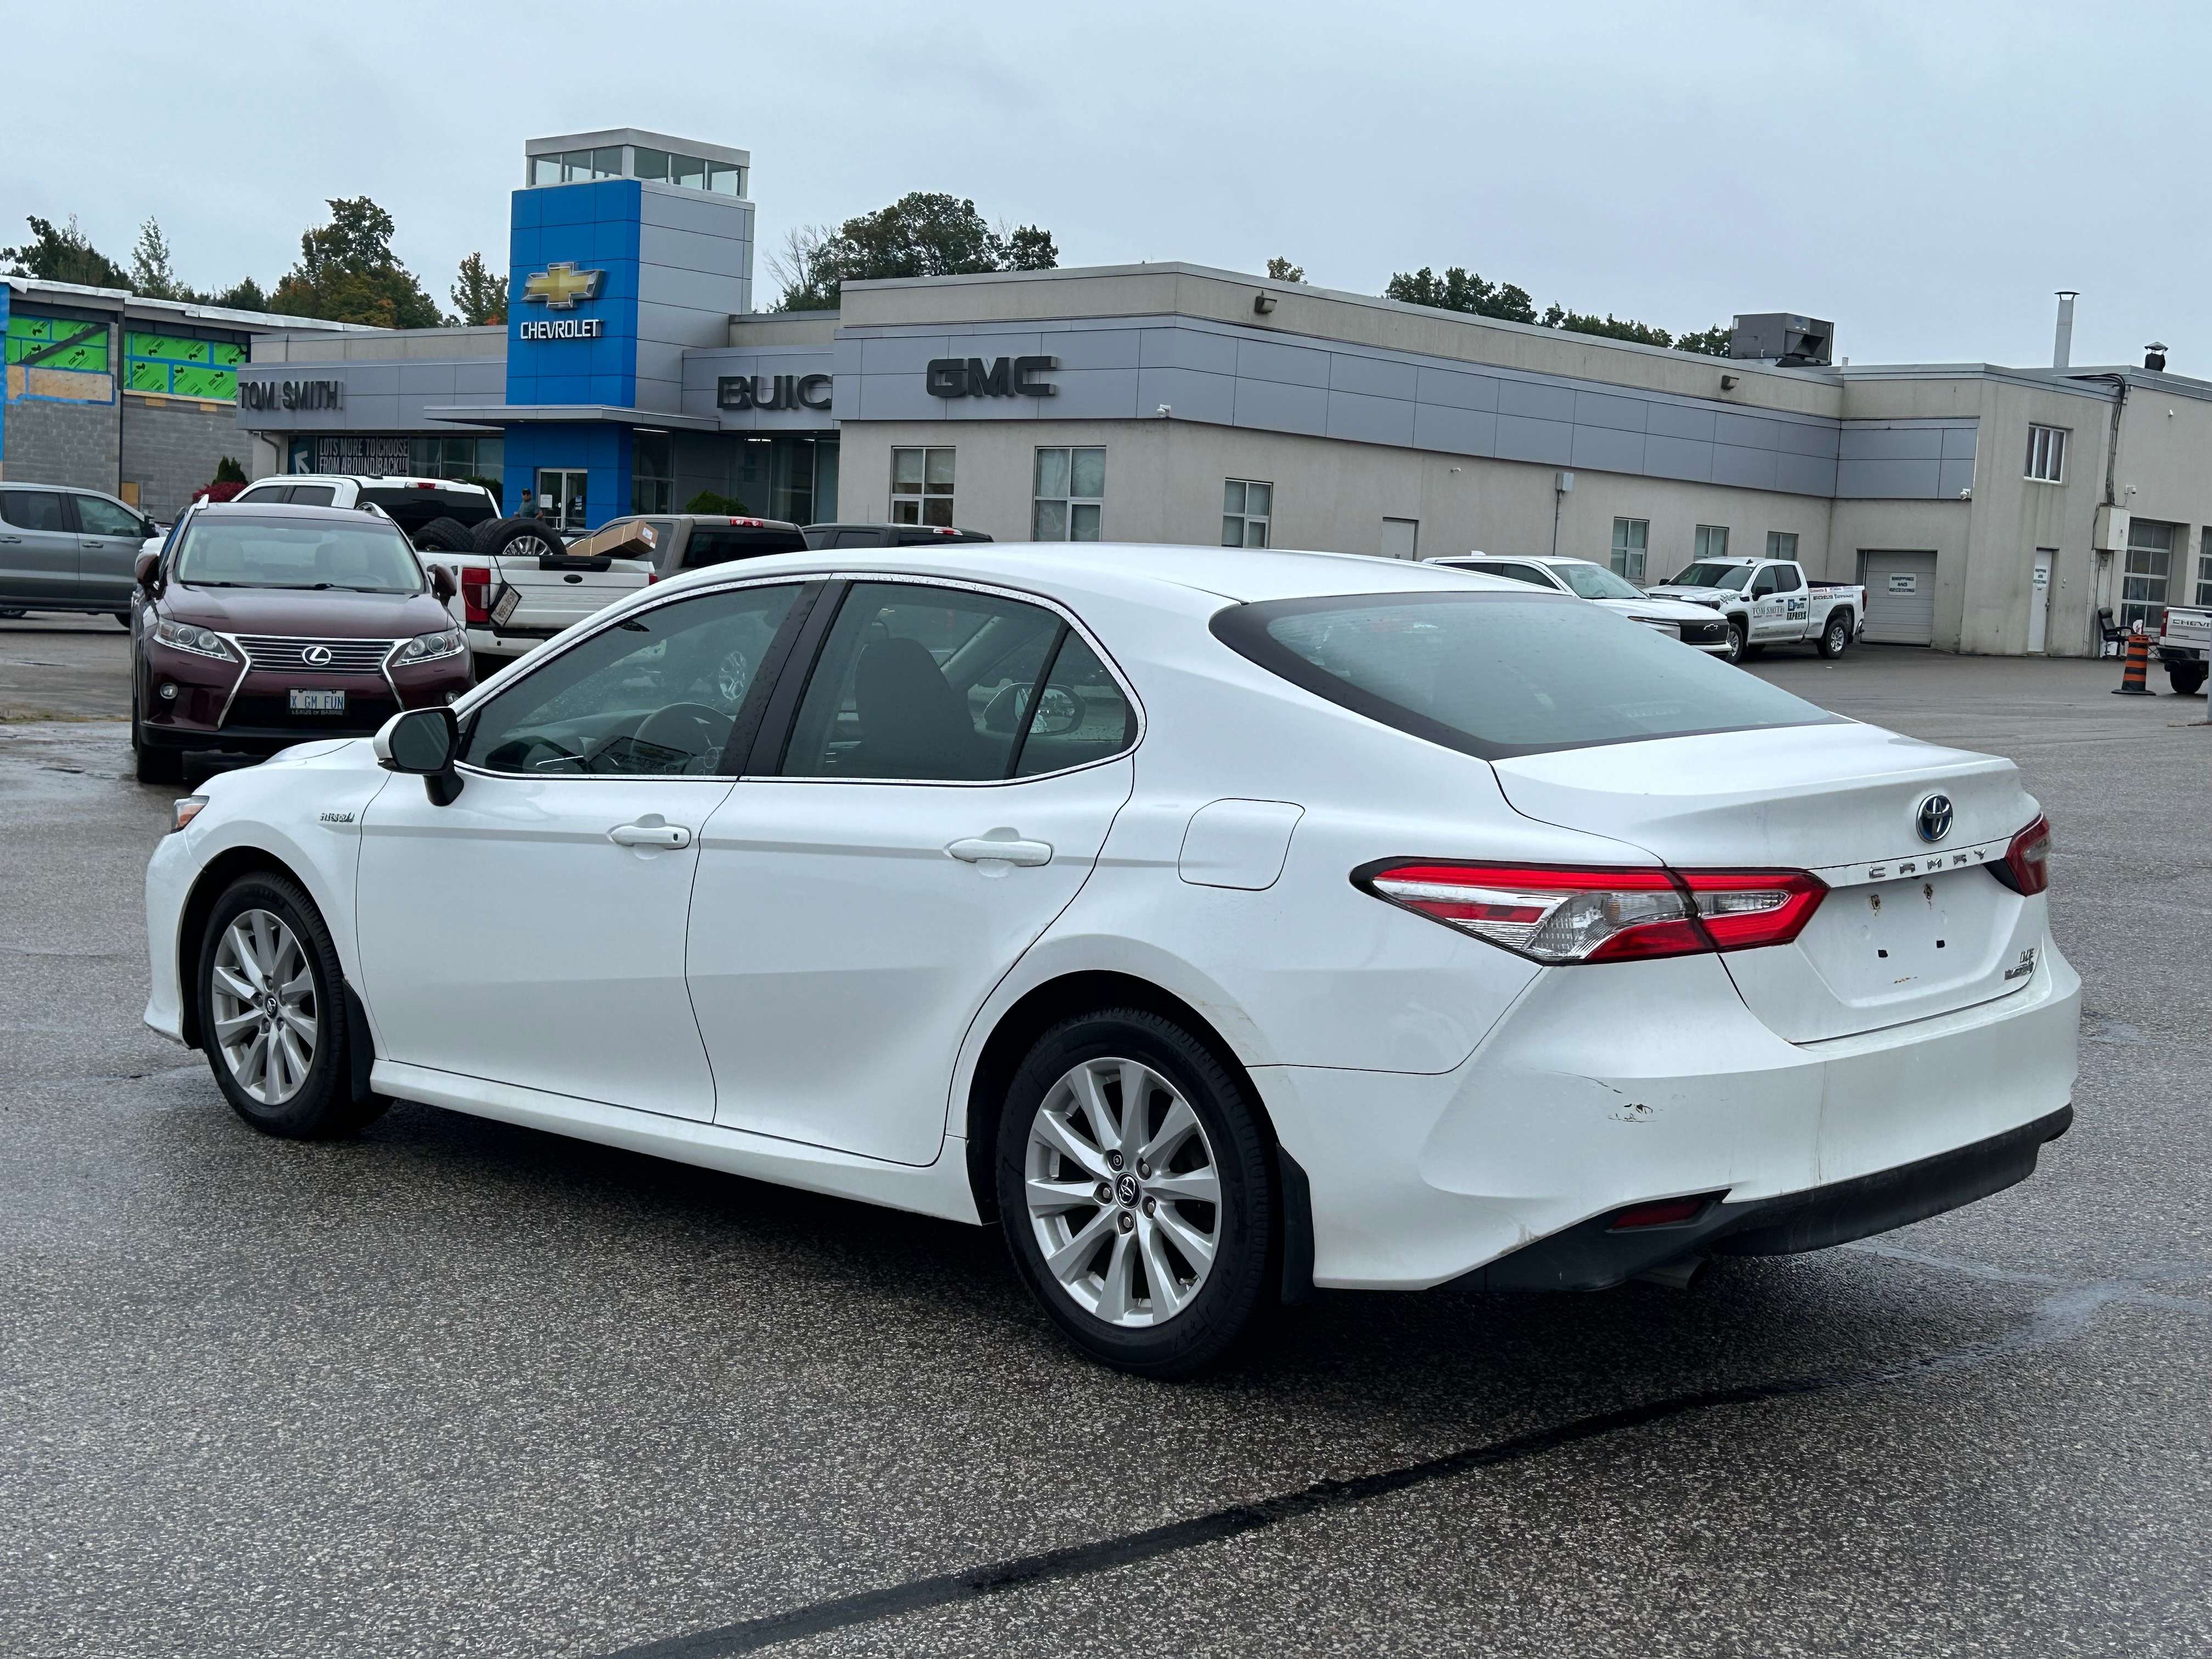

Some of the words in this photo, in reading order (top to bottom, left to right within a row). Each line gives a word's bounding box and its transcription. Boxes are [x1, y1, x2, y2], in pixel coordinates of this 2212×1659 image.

[521, 319, 600, 339] CHEVROLET
[926, 356, 1058, 397] GMC
[238, 381, 280, 410] TOM
[283, 381, 343, 410] SMITH
[319, 438, 338, 456] LOTS
[340, 438, 363, 456] MORE
[366, 438, 376, 456] TO
[378, 438, 408, 456] CHOOSE
[319, 456, 340, 473] FROM
[341, 456, 375, 475] AROUND
[291, 696, 297, 708] X
[325, 696, 343, 709] FUN
[1869, 849, 1987, 879] CAMRY
